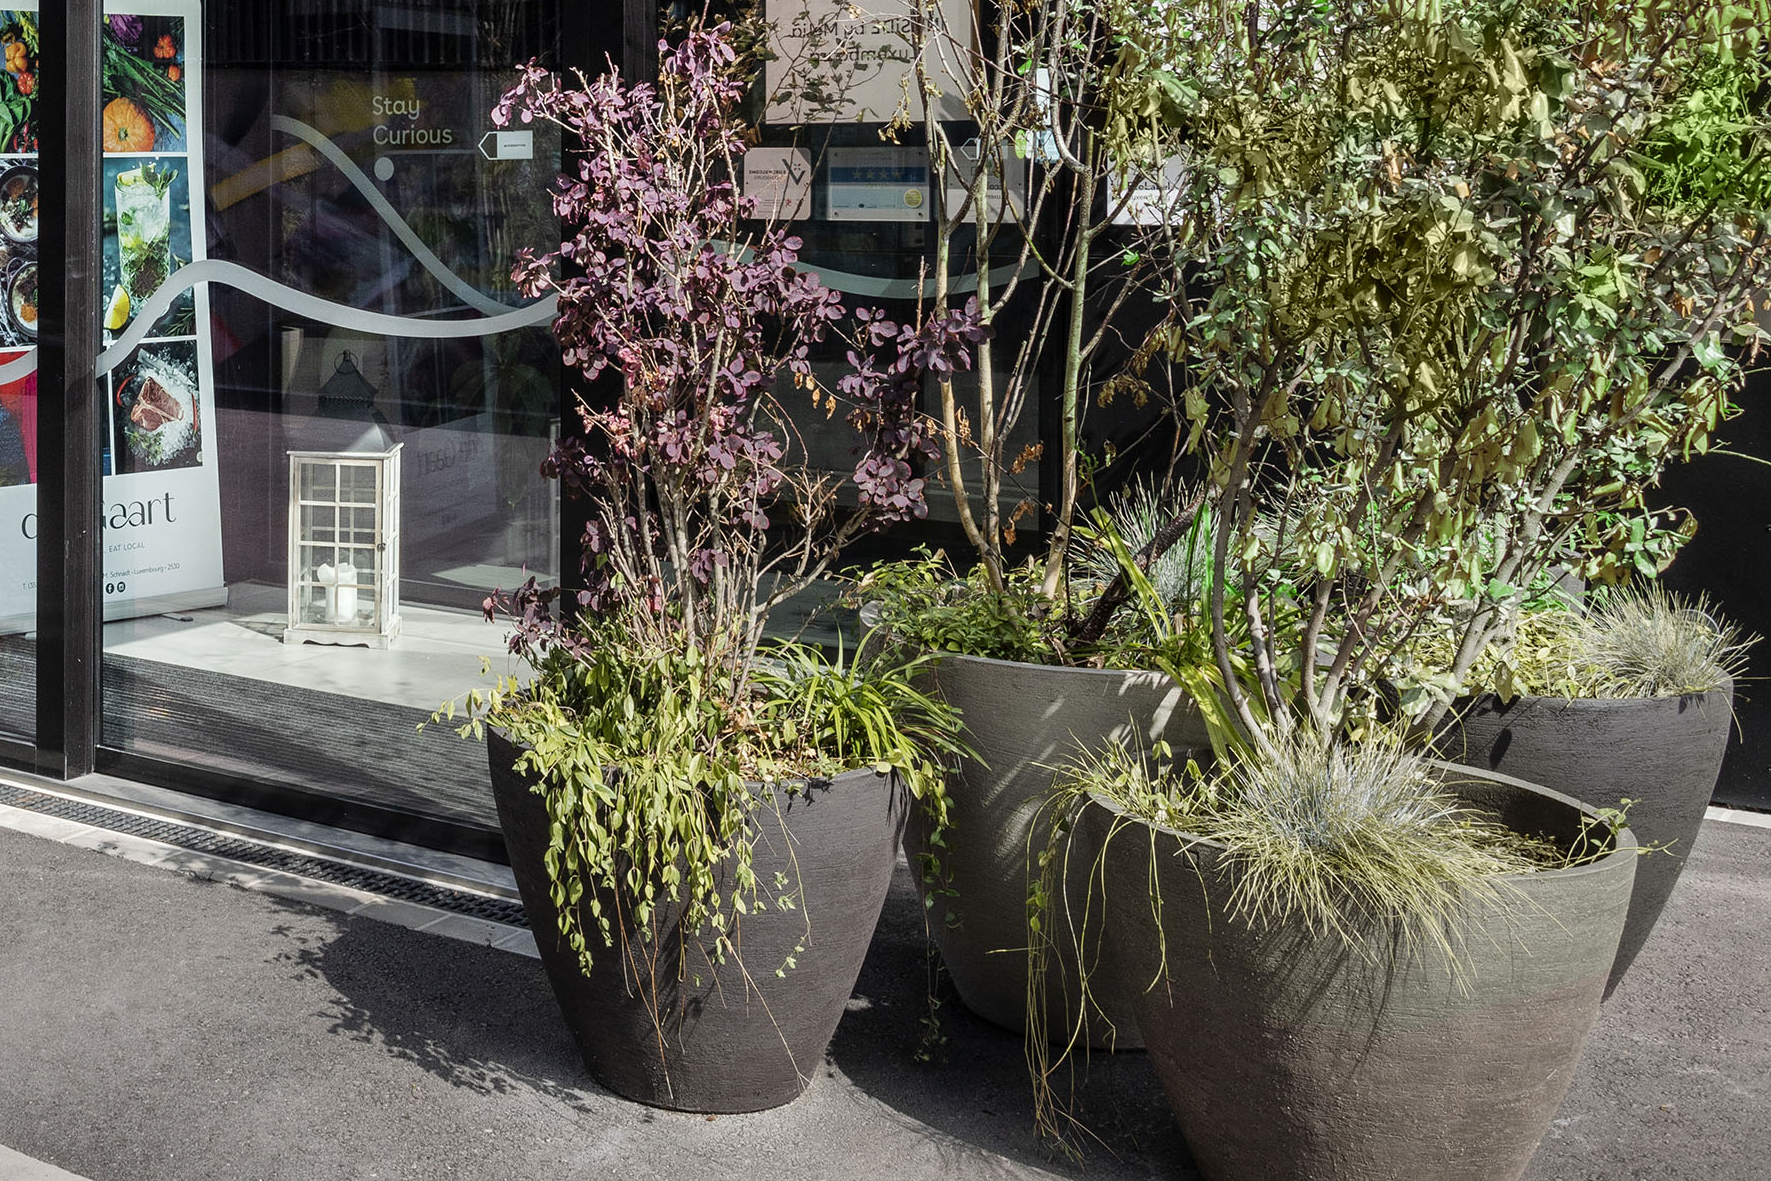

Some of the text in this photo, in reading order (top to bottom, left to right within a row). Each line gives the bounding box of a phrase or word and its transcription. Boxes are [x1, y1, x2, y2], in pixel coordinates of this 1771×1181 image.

[372, 95, 420, 120] Stay
[373, 124, 453, 145] Curious
[108, 541, 146, 553] EAT LOCAL
